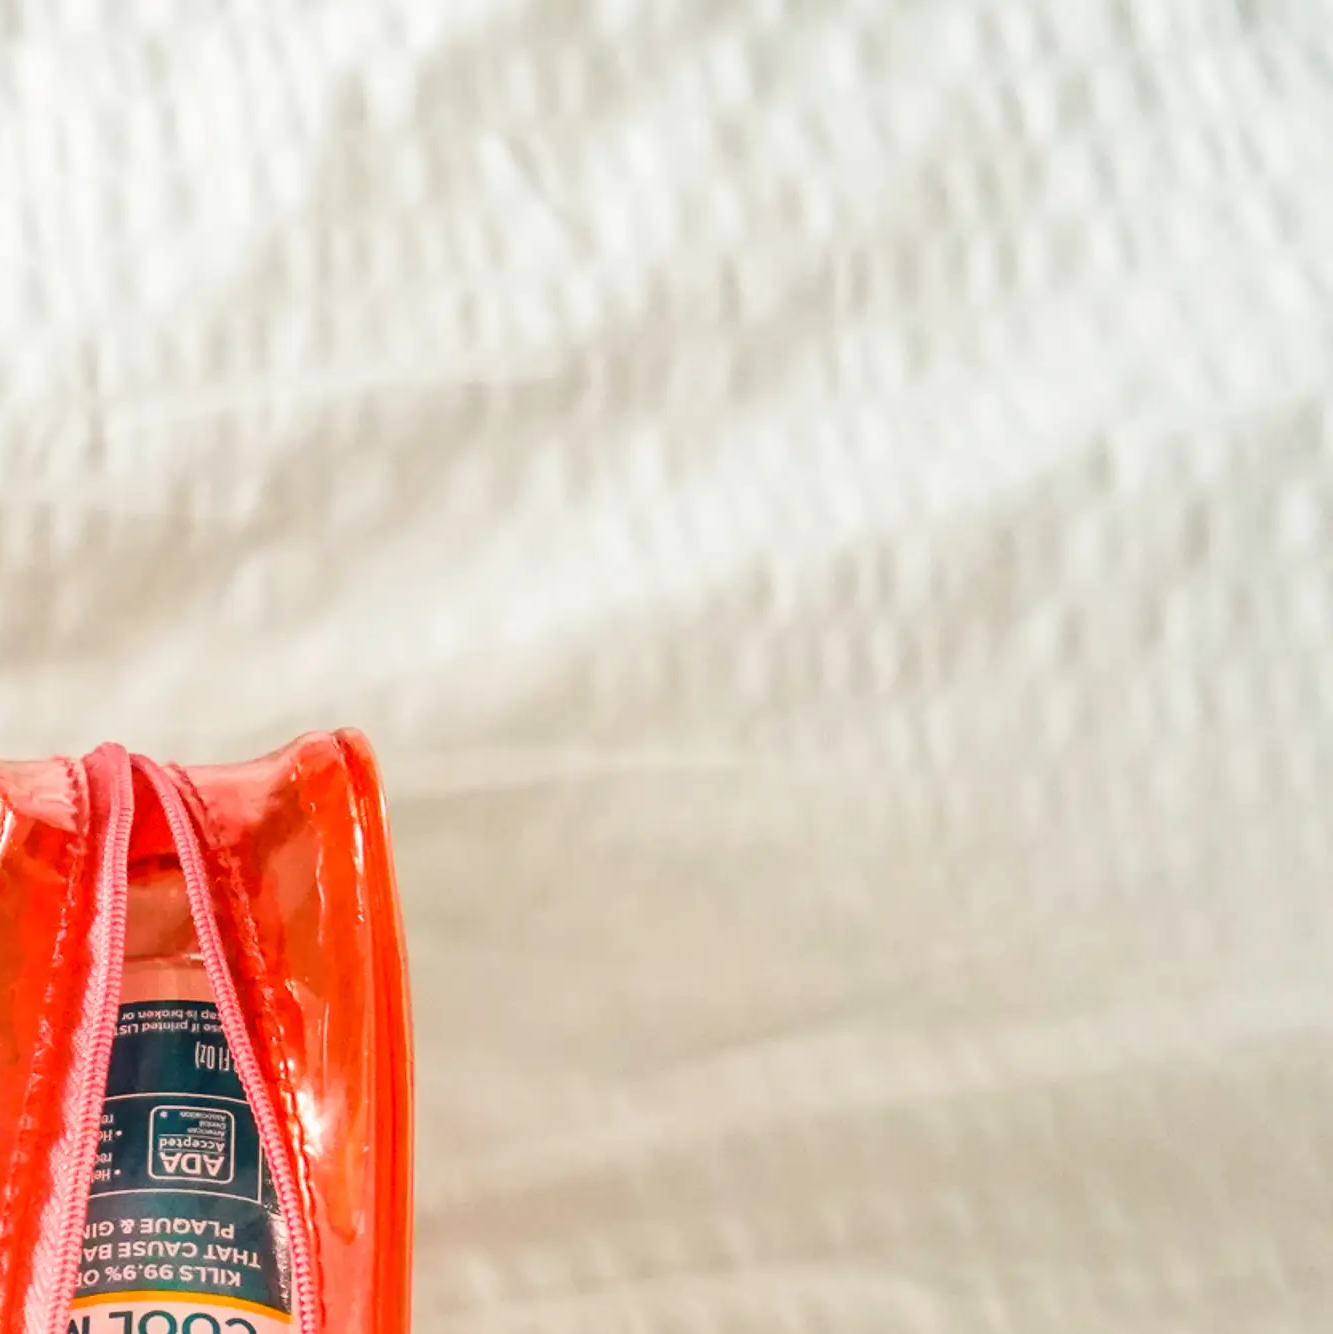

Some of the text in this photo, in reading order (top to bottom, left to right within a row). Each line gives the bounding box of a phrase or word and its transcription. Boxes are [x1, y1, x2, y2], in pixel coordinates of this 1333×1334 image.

[137, 1010, 183, 1021] broken
[141, 1020, 188, 1032] printed
[195, 1041, 215, 1070] Oz)
[159, 1137, 225, 1152] Accepted
[159, 1152, 225, 1176] ADA
[120, 1219, 135, 1234] &
[140, 1217, 235, 1239] PLAQUE
[79, 1240, 261, 1269] THAT CAUSE BA
[105, 1264, 173, 1281] 99.9%
[179, 1266, 241, 1287] KILLS
